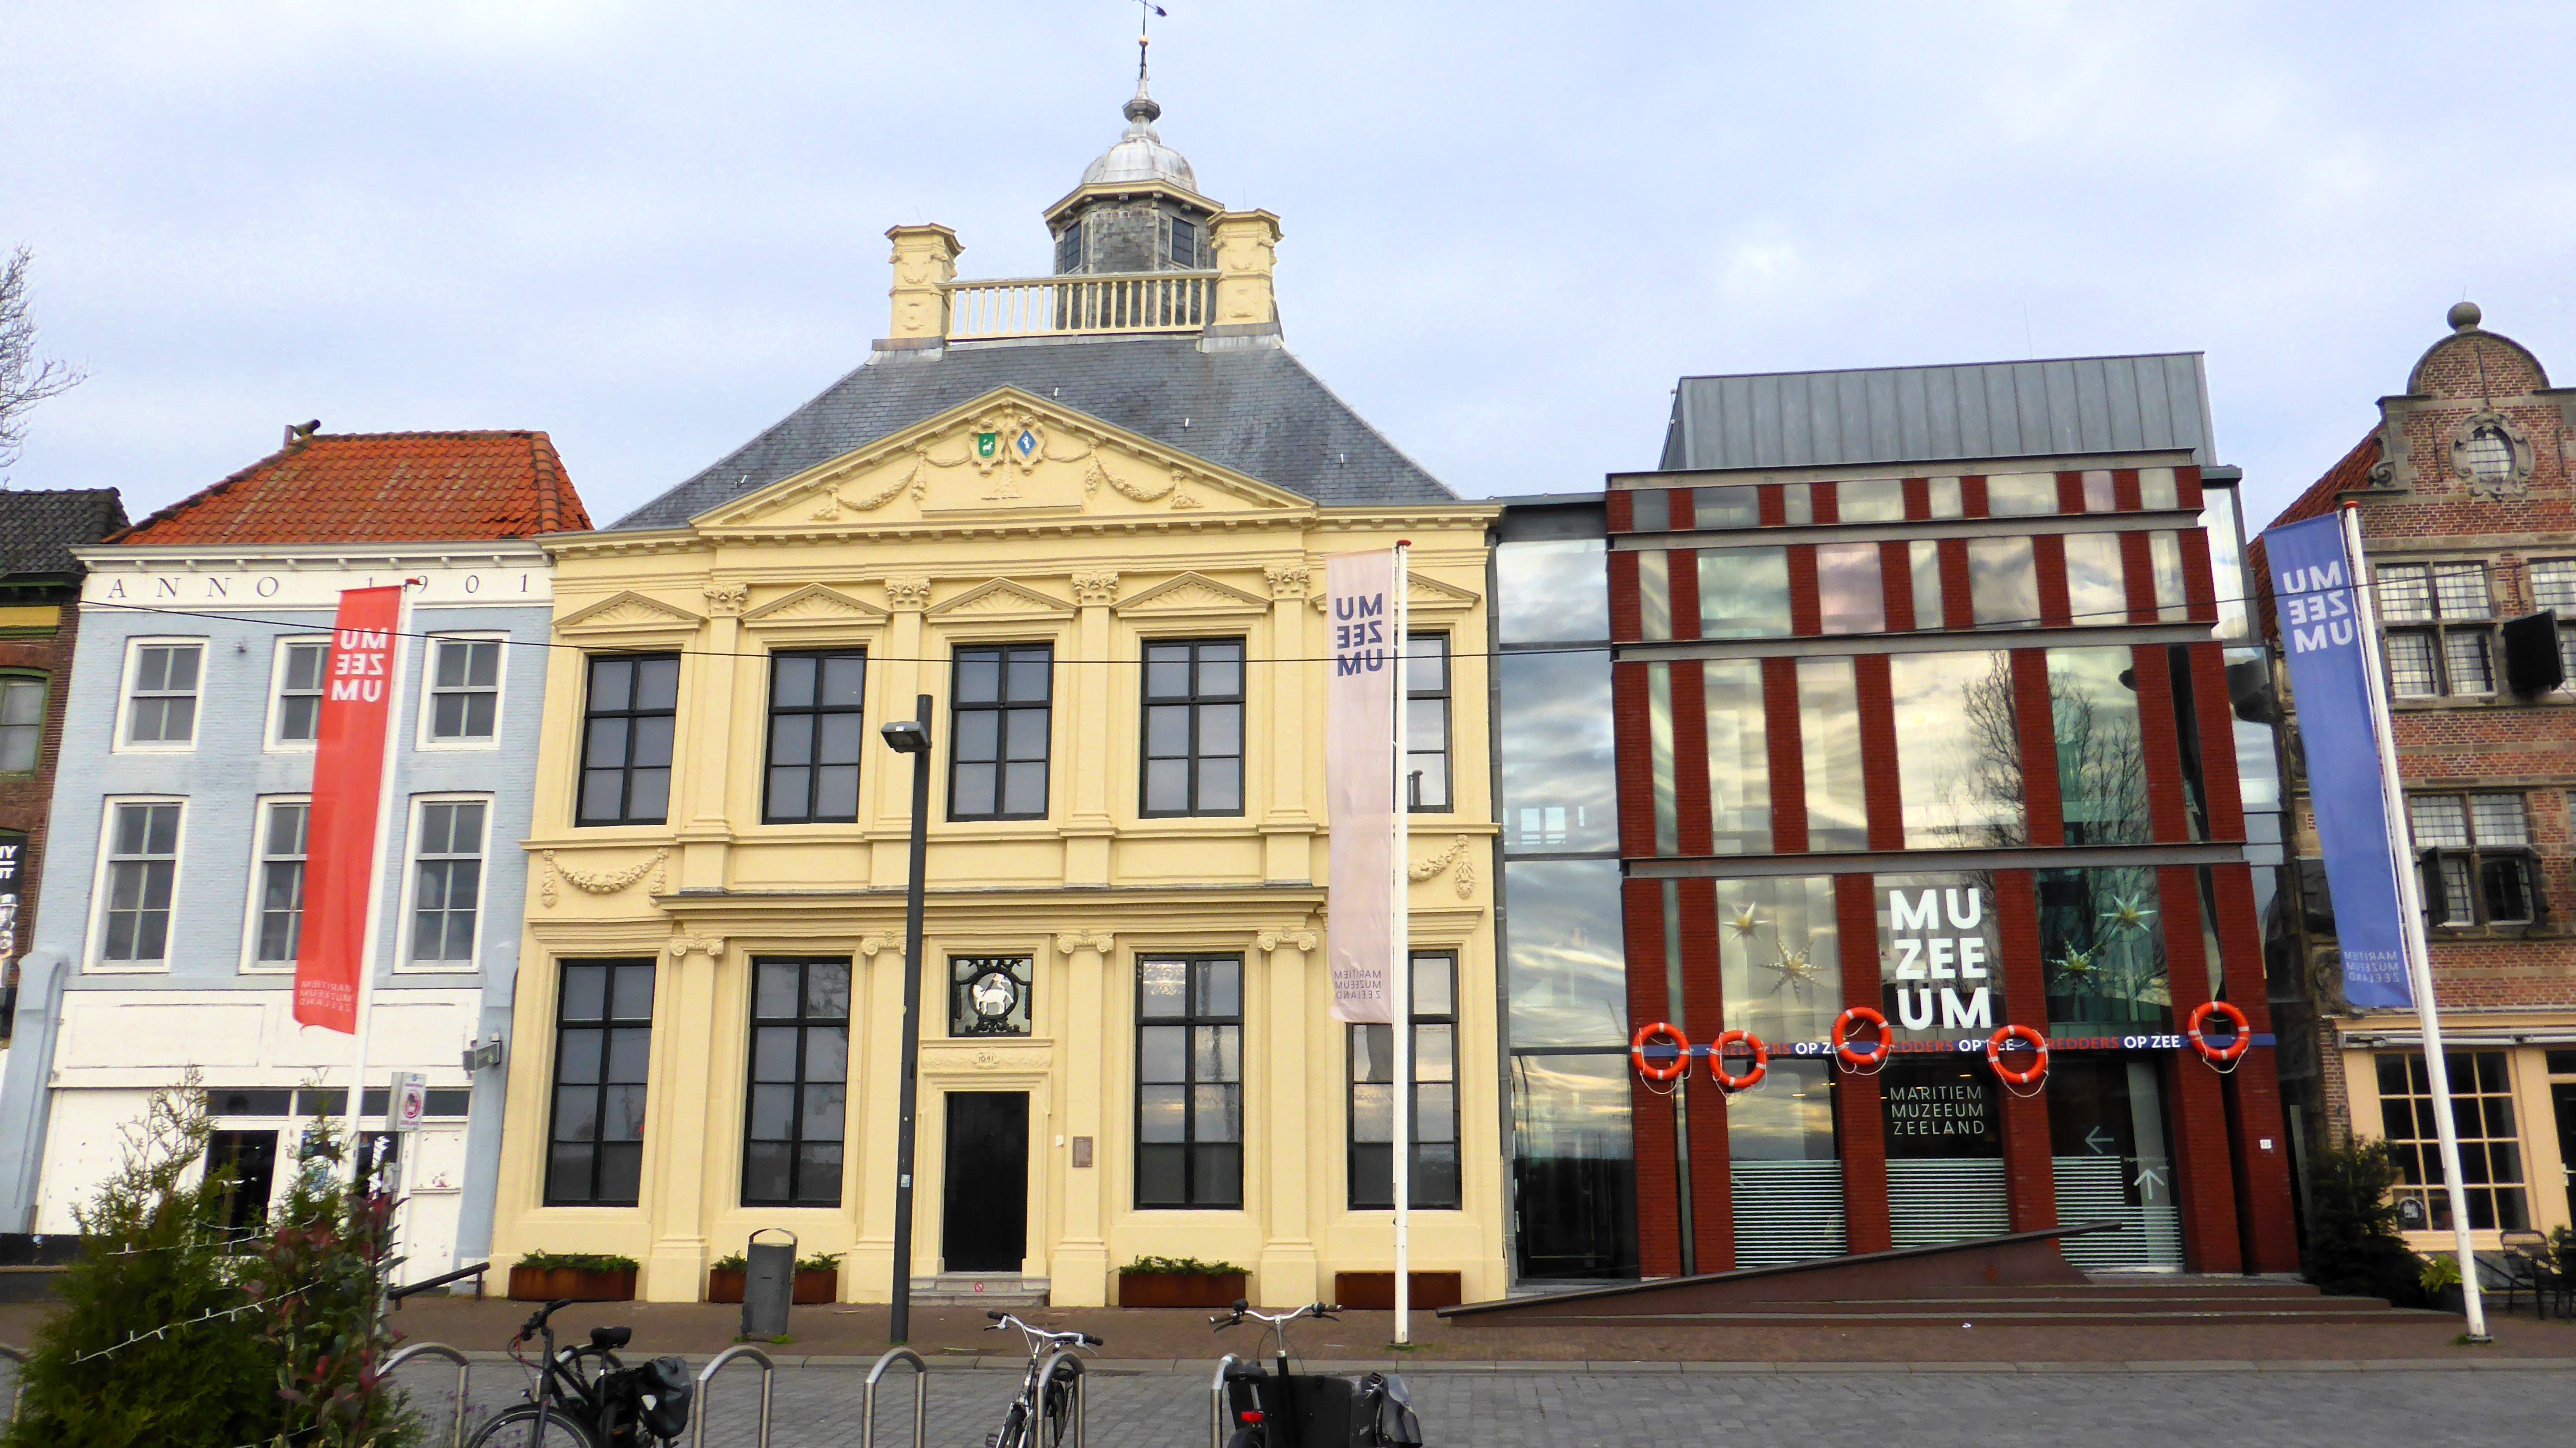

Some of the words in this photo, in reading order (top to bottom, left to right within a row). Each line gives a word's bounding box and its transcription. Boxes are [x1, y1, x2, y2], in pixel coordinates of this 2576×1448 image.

[107, 576, 279, 598] ANNO
[366, 573, 528, 594] 1901
[1889, 888, 1981, 930] MU
[1894, 937, 1987, 980] ZEE
[1897, 987, 1991, 1030] UM
[1795, 1042, 1818, 1054] OP
[1891, 1040, 1954, 1053] EDDERS
[1958, 1040, 1981, 1052] OP
[2046, 1036, 2120, 1050] REDDERS
[2124, 1035, 2147, 1049] OP
[2151, 1034, 2181, 1048] ZEE
[1890, 1085, 1983, 1101] MARITIEM
[1891, 1103, 1984, 1118] MUZEEUM
[1893, 1120, 1985, 1135] ZEELAND
